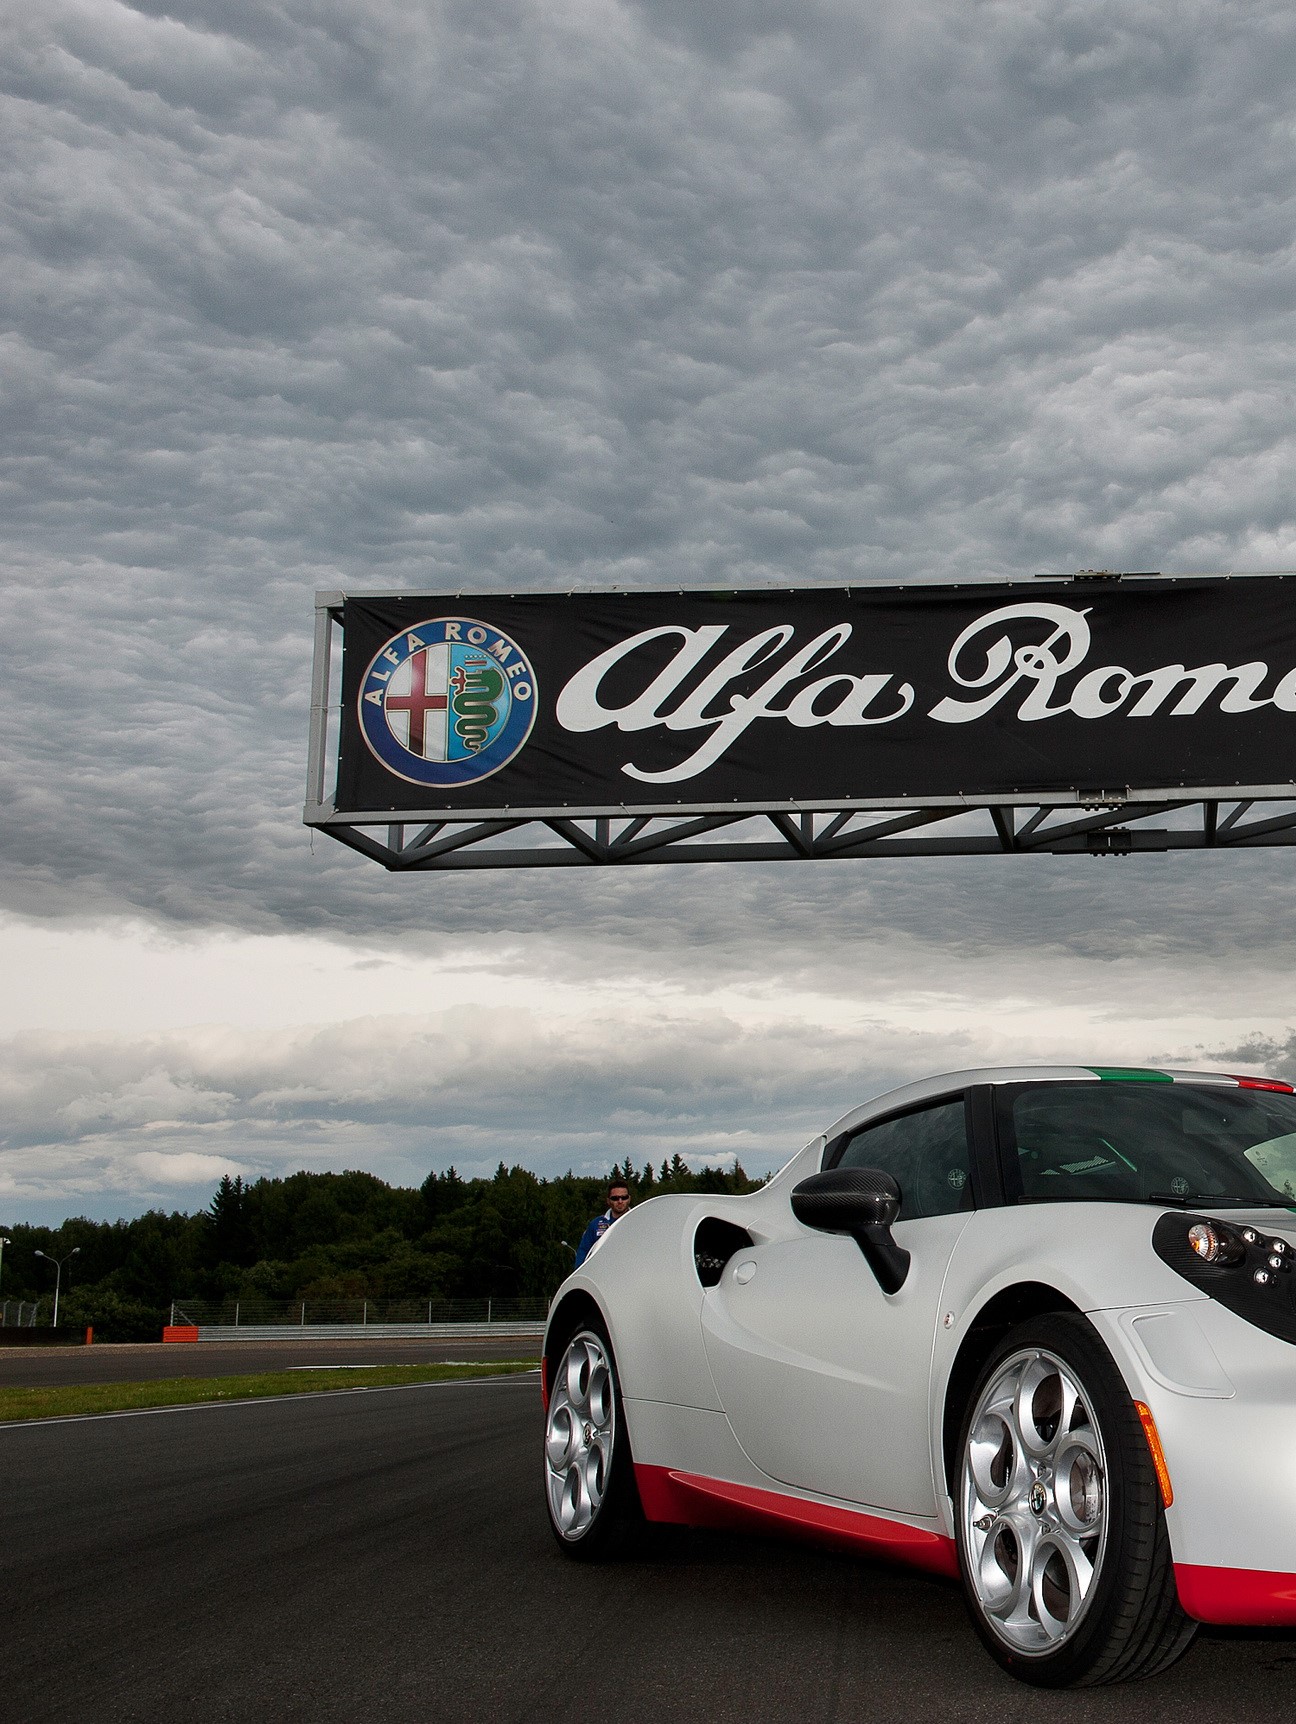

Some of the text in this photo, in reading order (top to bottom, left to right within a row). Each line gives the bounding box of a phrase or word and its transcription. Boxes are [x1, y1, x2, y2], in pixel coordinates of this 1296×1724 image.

[365, 622, 532, 706] ALFA ROMEO
[556, 623, 914, 784] Alfa
